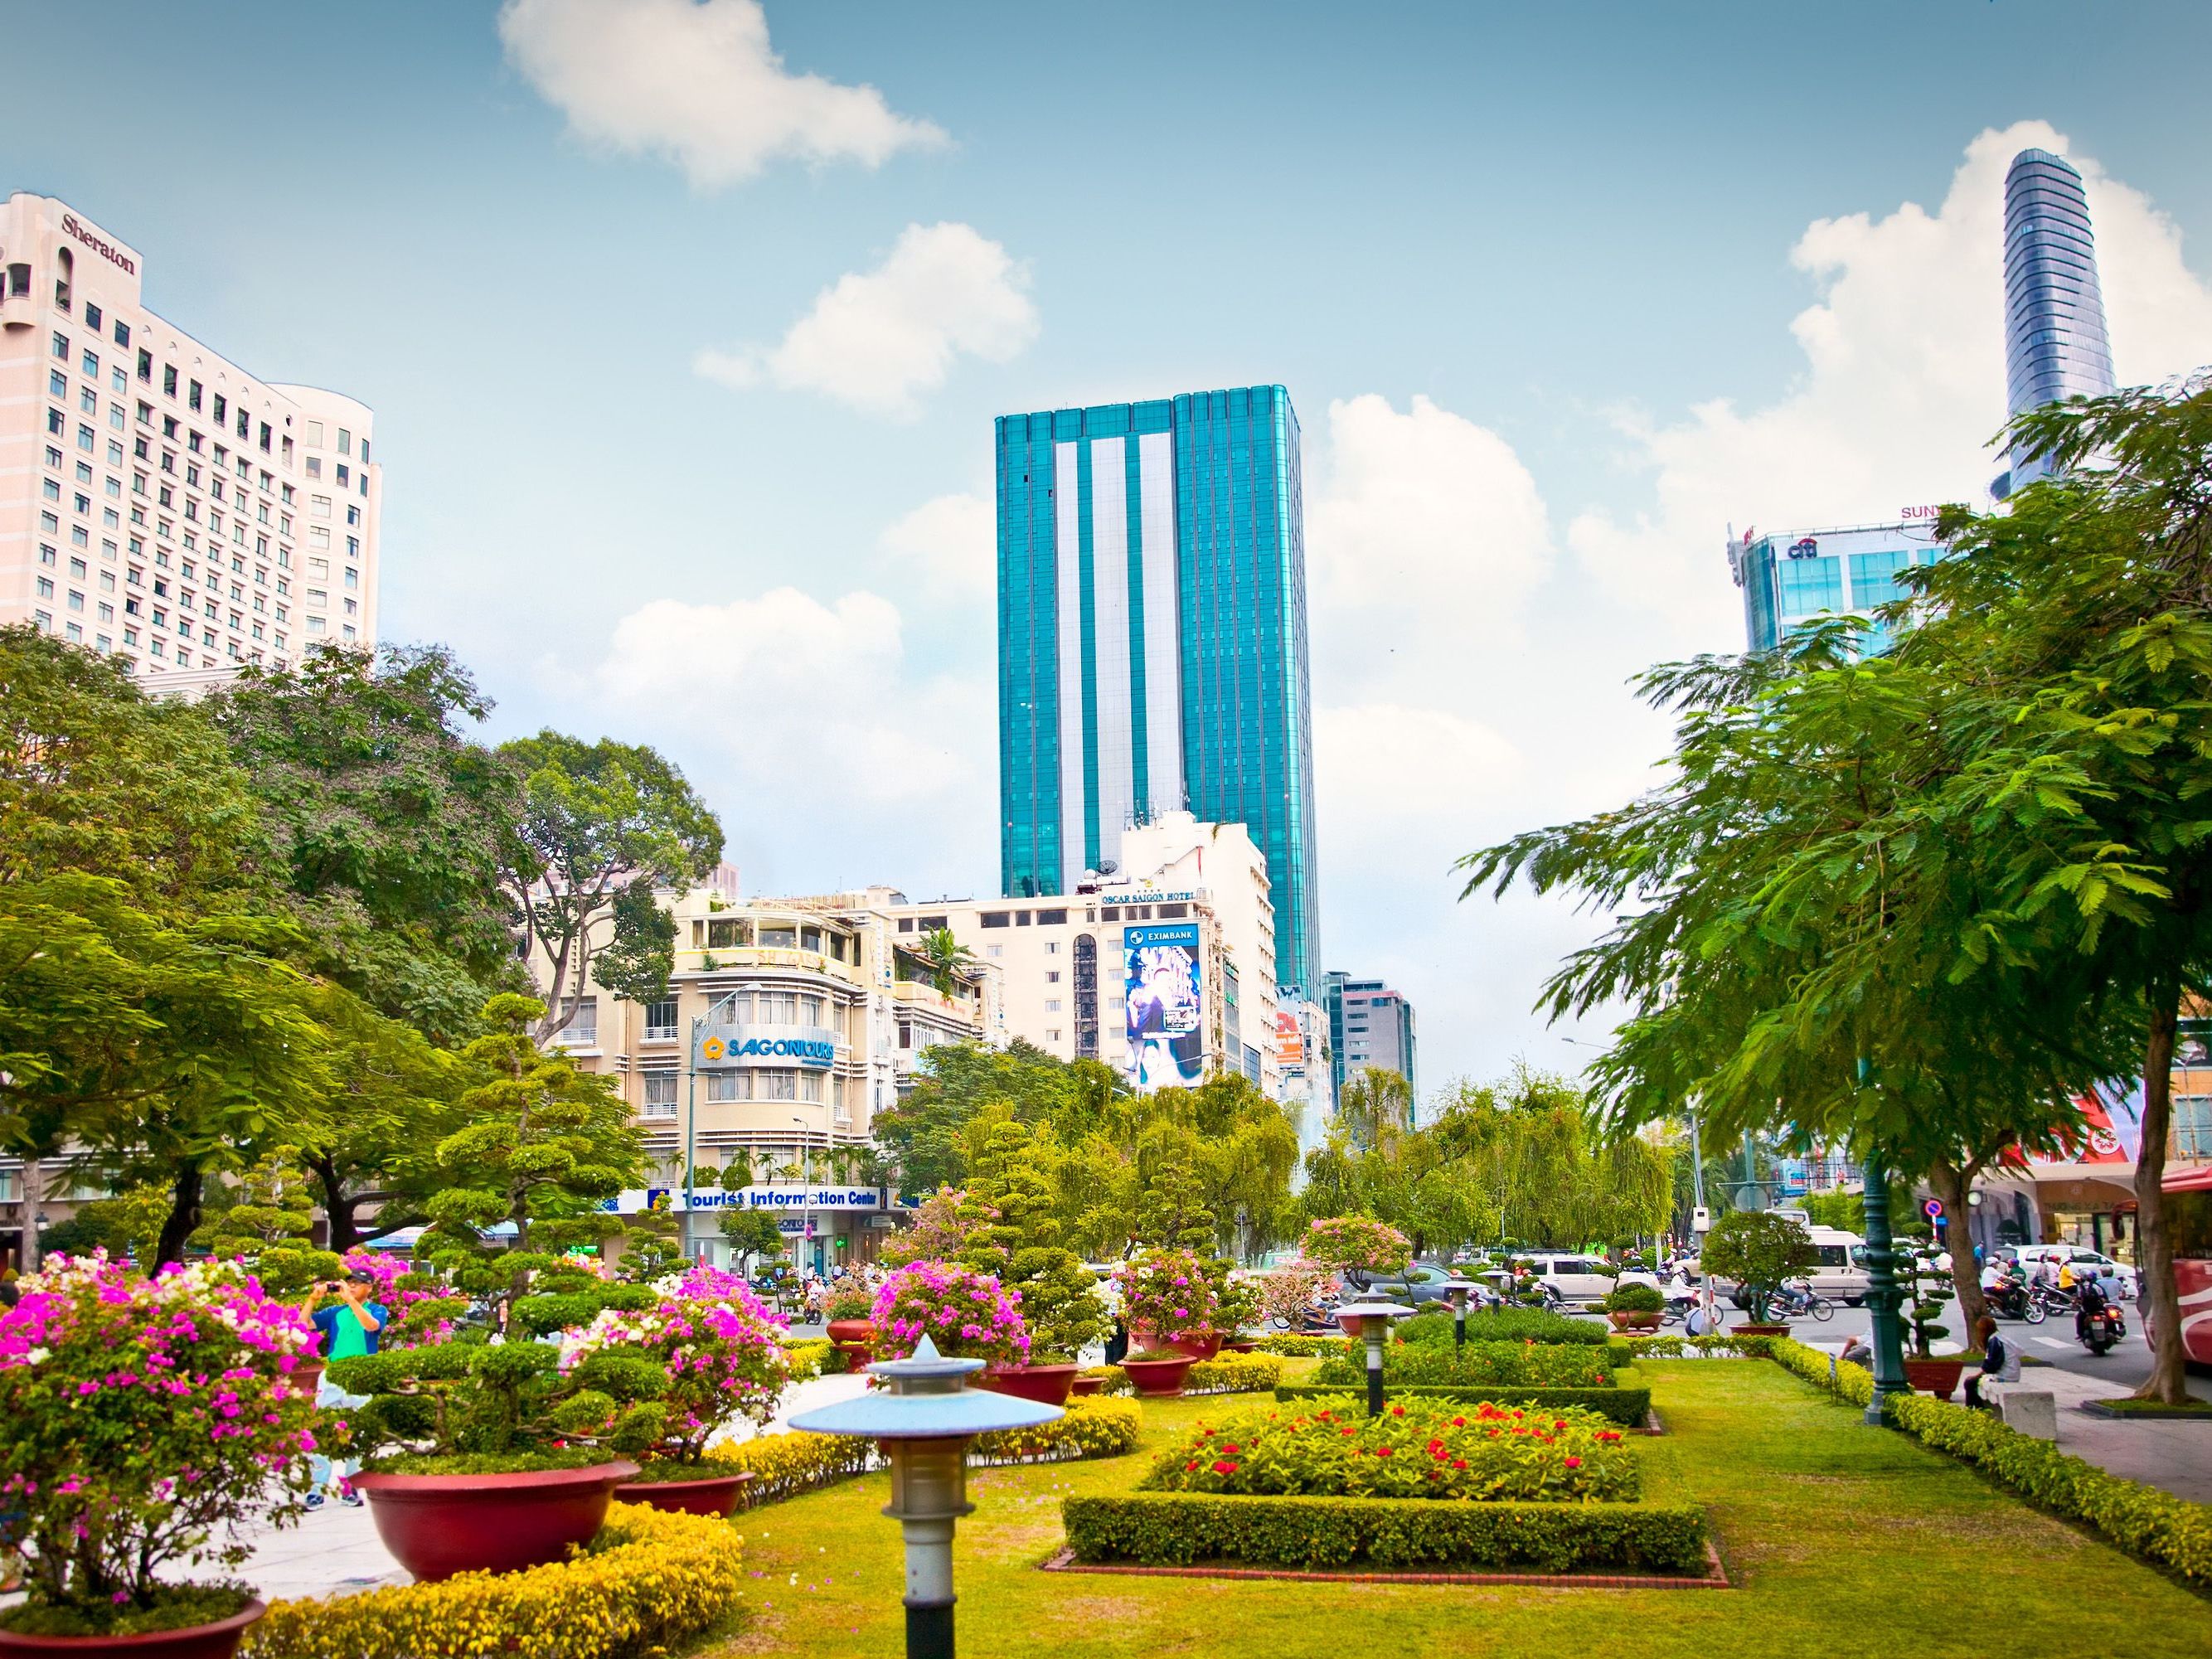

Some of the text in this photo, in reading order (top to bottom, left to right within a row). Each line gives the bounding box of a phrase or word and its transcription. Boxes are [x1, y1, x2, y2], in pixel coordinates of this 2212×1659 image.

[61, 213, 135, 276] Sheraton
[1102, 891, 1196, 905] OSCAR SAIGON HOTEL
[1147, 931, 1193, 941] EXIMBANK
